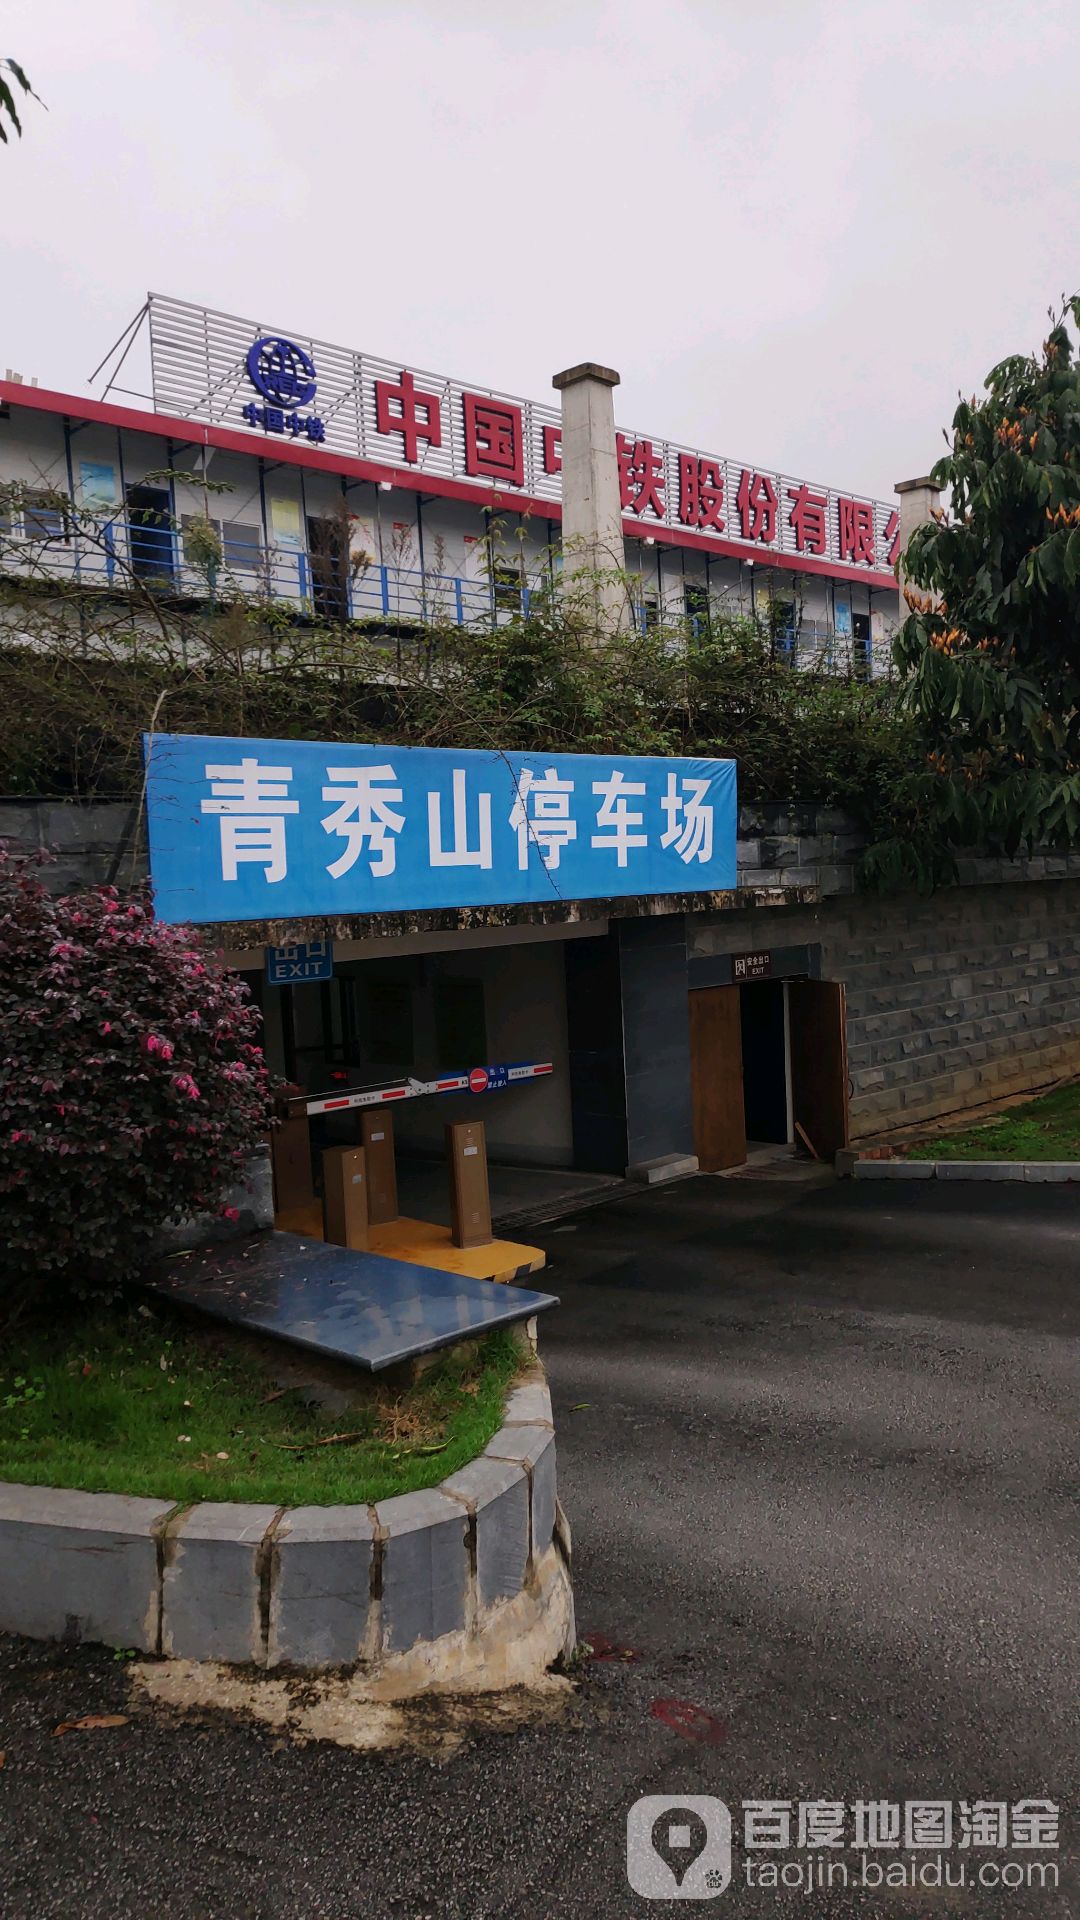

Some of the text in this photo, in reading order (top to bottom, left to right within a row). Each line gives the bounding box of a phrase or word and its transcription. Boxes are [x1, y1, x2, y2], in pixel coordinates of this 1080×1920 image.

[243, 402, 325, 442] 中国中铁
[201, 758, 715, 884] 青秀山停车场
[747, 955, 769, 966] 安全出口
[275, 961, 323, 978] EXIT
[752, 967, 764, 975] EXIT
